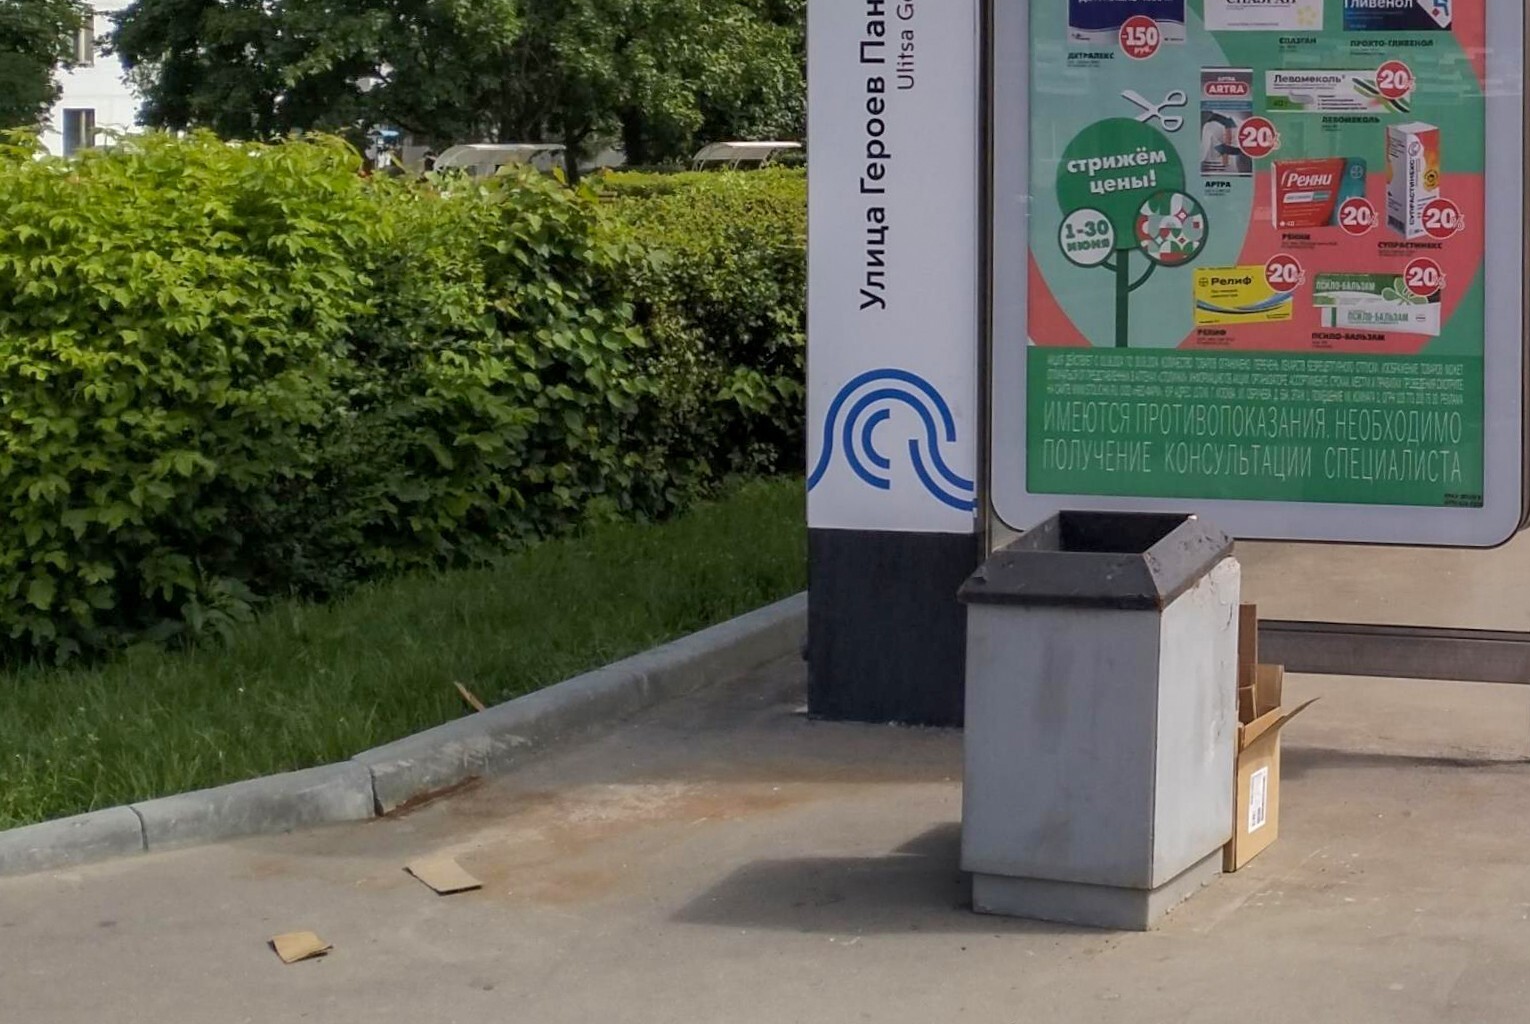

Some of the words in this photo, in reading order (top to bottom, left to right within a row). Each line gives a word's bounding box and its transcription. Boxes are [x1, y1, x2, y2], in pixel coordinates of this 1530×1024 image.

[1121, 26, 1158, 46] -150
[896, 30, 914, 90] Ulitsa
[1209, 84, 1245, 94] ARTRA
[1273, 74, 1342, 84] Левомеколь
[860, 76, 891, 194] Героев
[1067, 146, 1167, 176] стрижём
[1090, 169, 1156, 194] цены!
[1287, 173, 1333, 188] Ренни
[1065, 219, 1110, 239] 1-30
[860, 207, 889, 311] Улица
[1211, 277, 1252, 286] Релиф
[1044, 401, 1130, 433] ИМЕЮТСЯ
[1136, 403, 1330, 439] ПРОТИВОПОКАЗАНИЯ.
[1335, 408, 1462, 446] НЕОБХОДИМО
[1043, 438, 1152, 473] ПОЛУЧЕНИЕ
[1165, 442, 1312, 481] КОНСУЛЬТАЦИИ
[1324, 447, 1462, 485] СПЕЦИАЛИСТА
